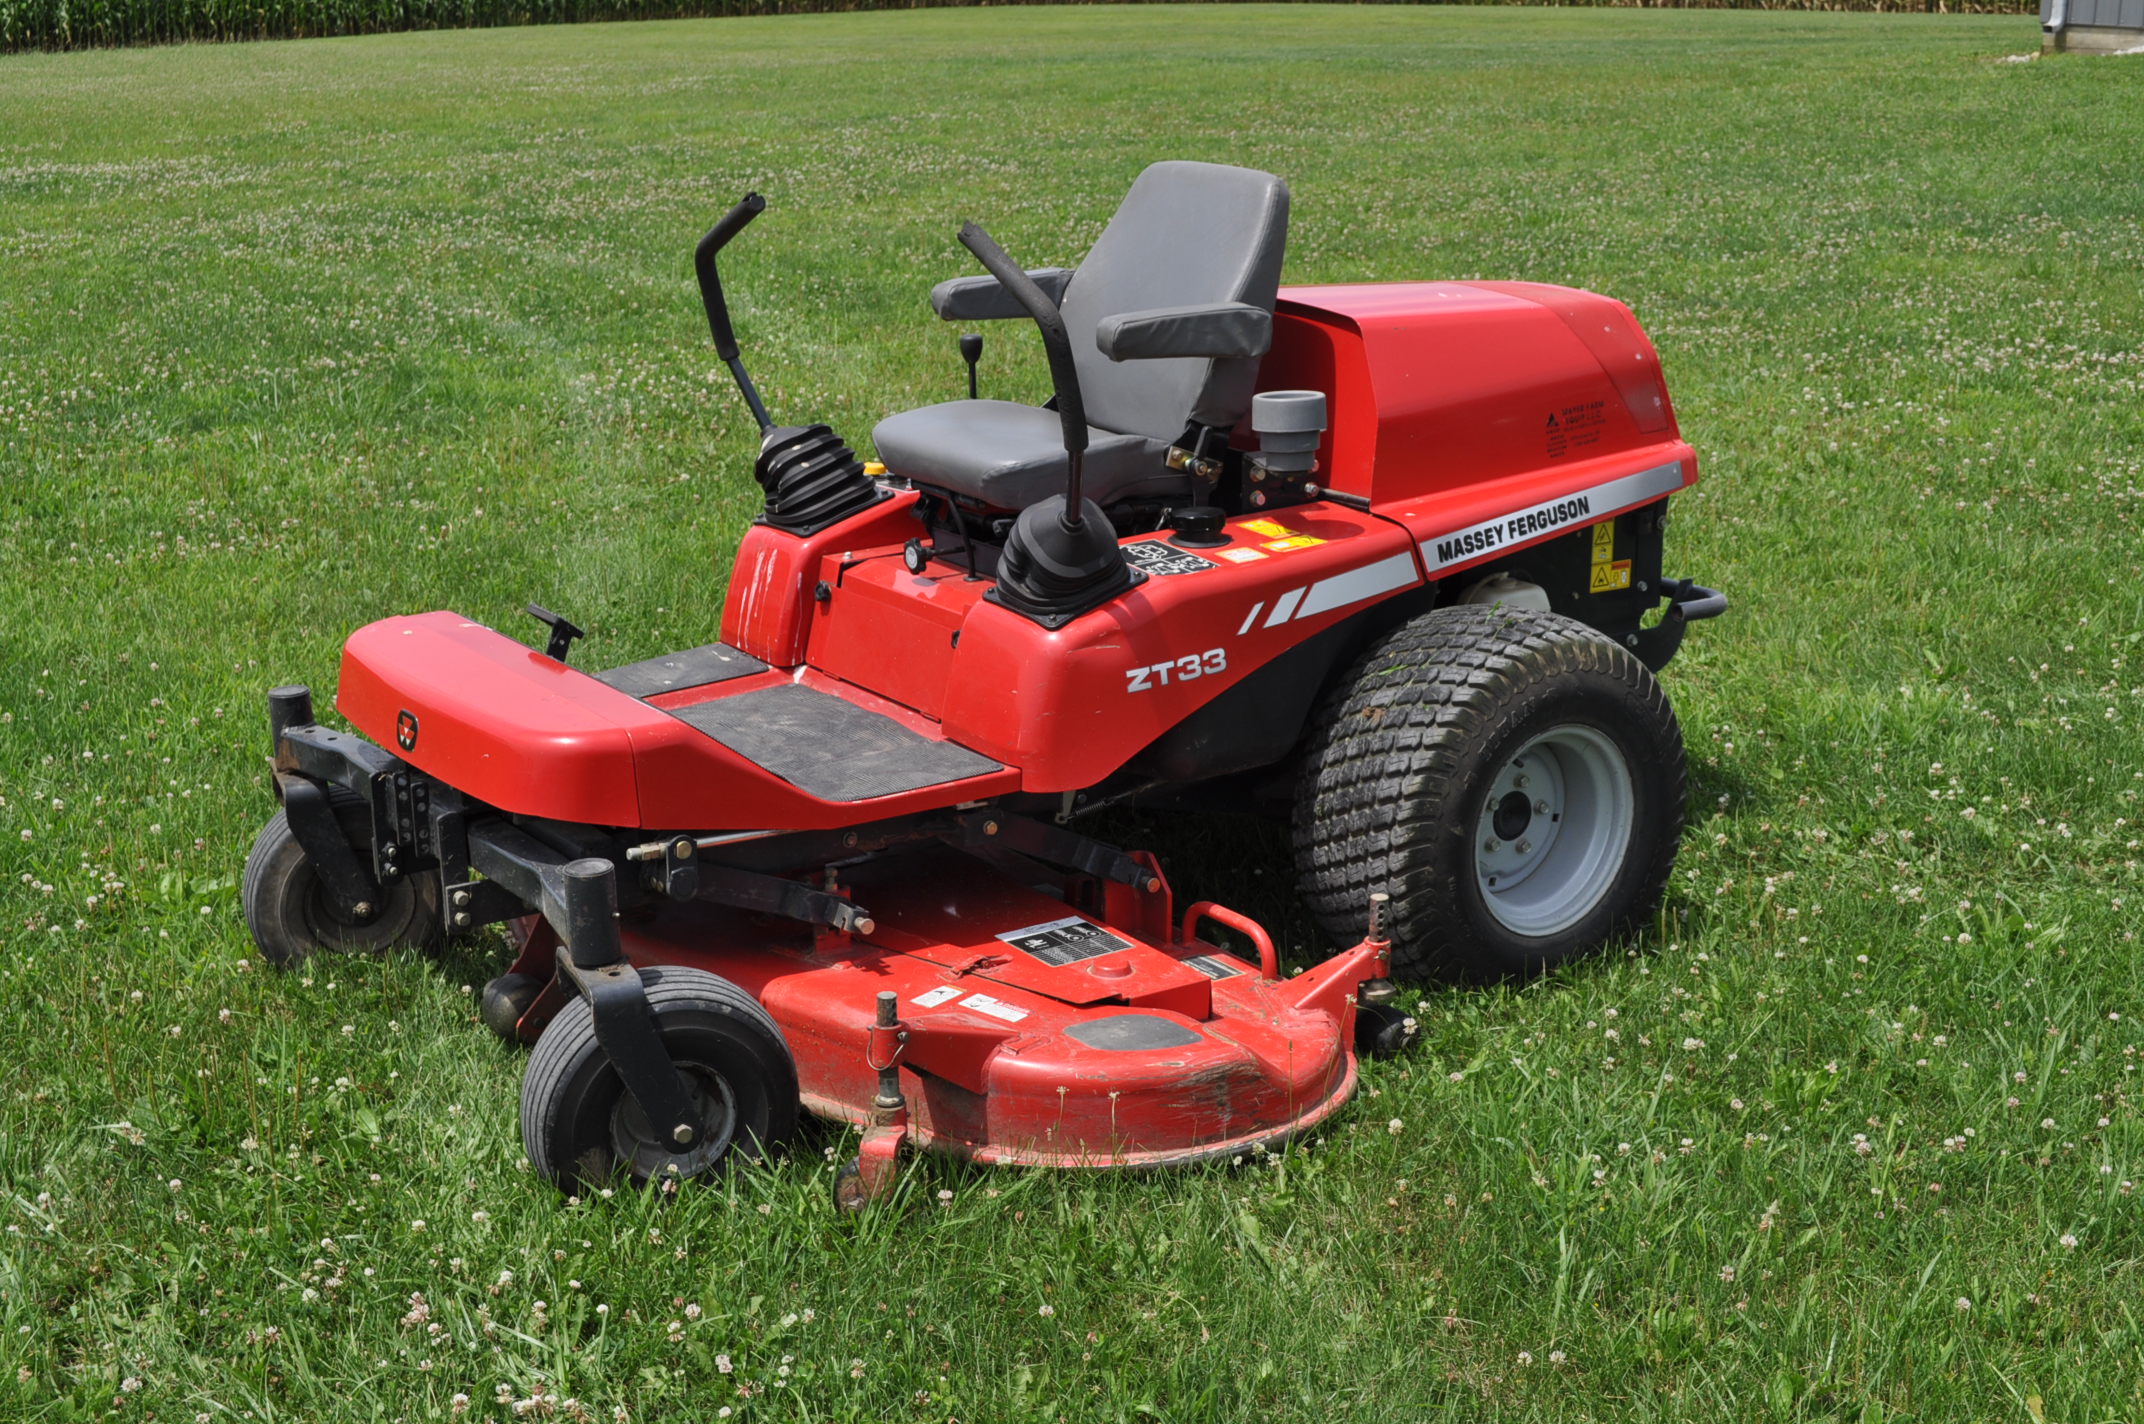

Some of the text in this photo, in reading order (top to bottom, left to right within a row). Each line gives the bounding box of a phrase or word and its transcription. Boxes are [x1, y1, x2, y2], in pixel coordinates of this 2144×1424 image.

[1437, 496, 1590, 563] MASSEY FERGUSON
[1125, 647, 1227, 693] ZT33
